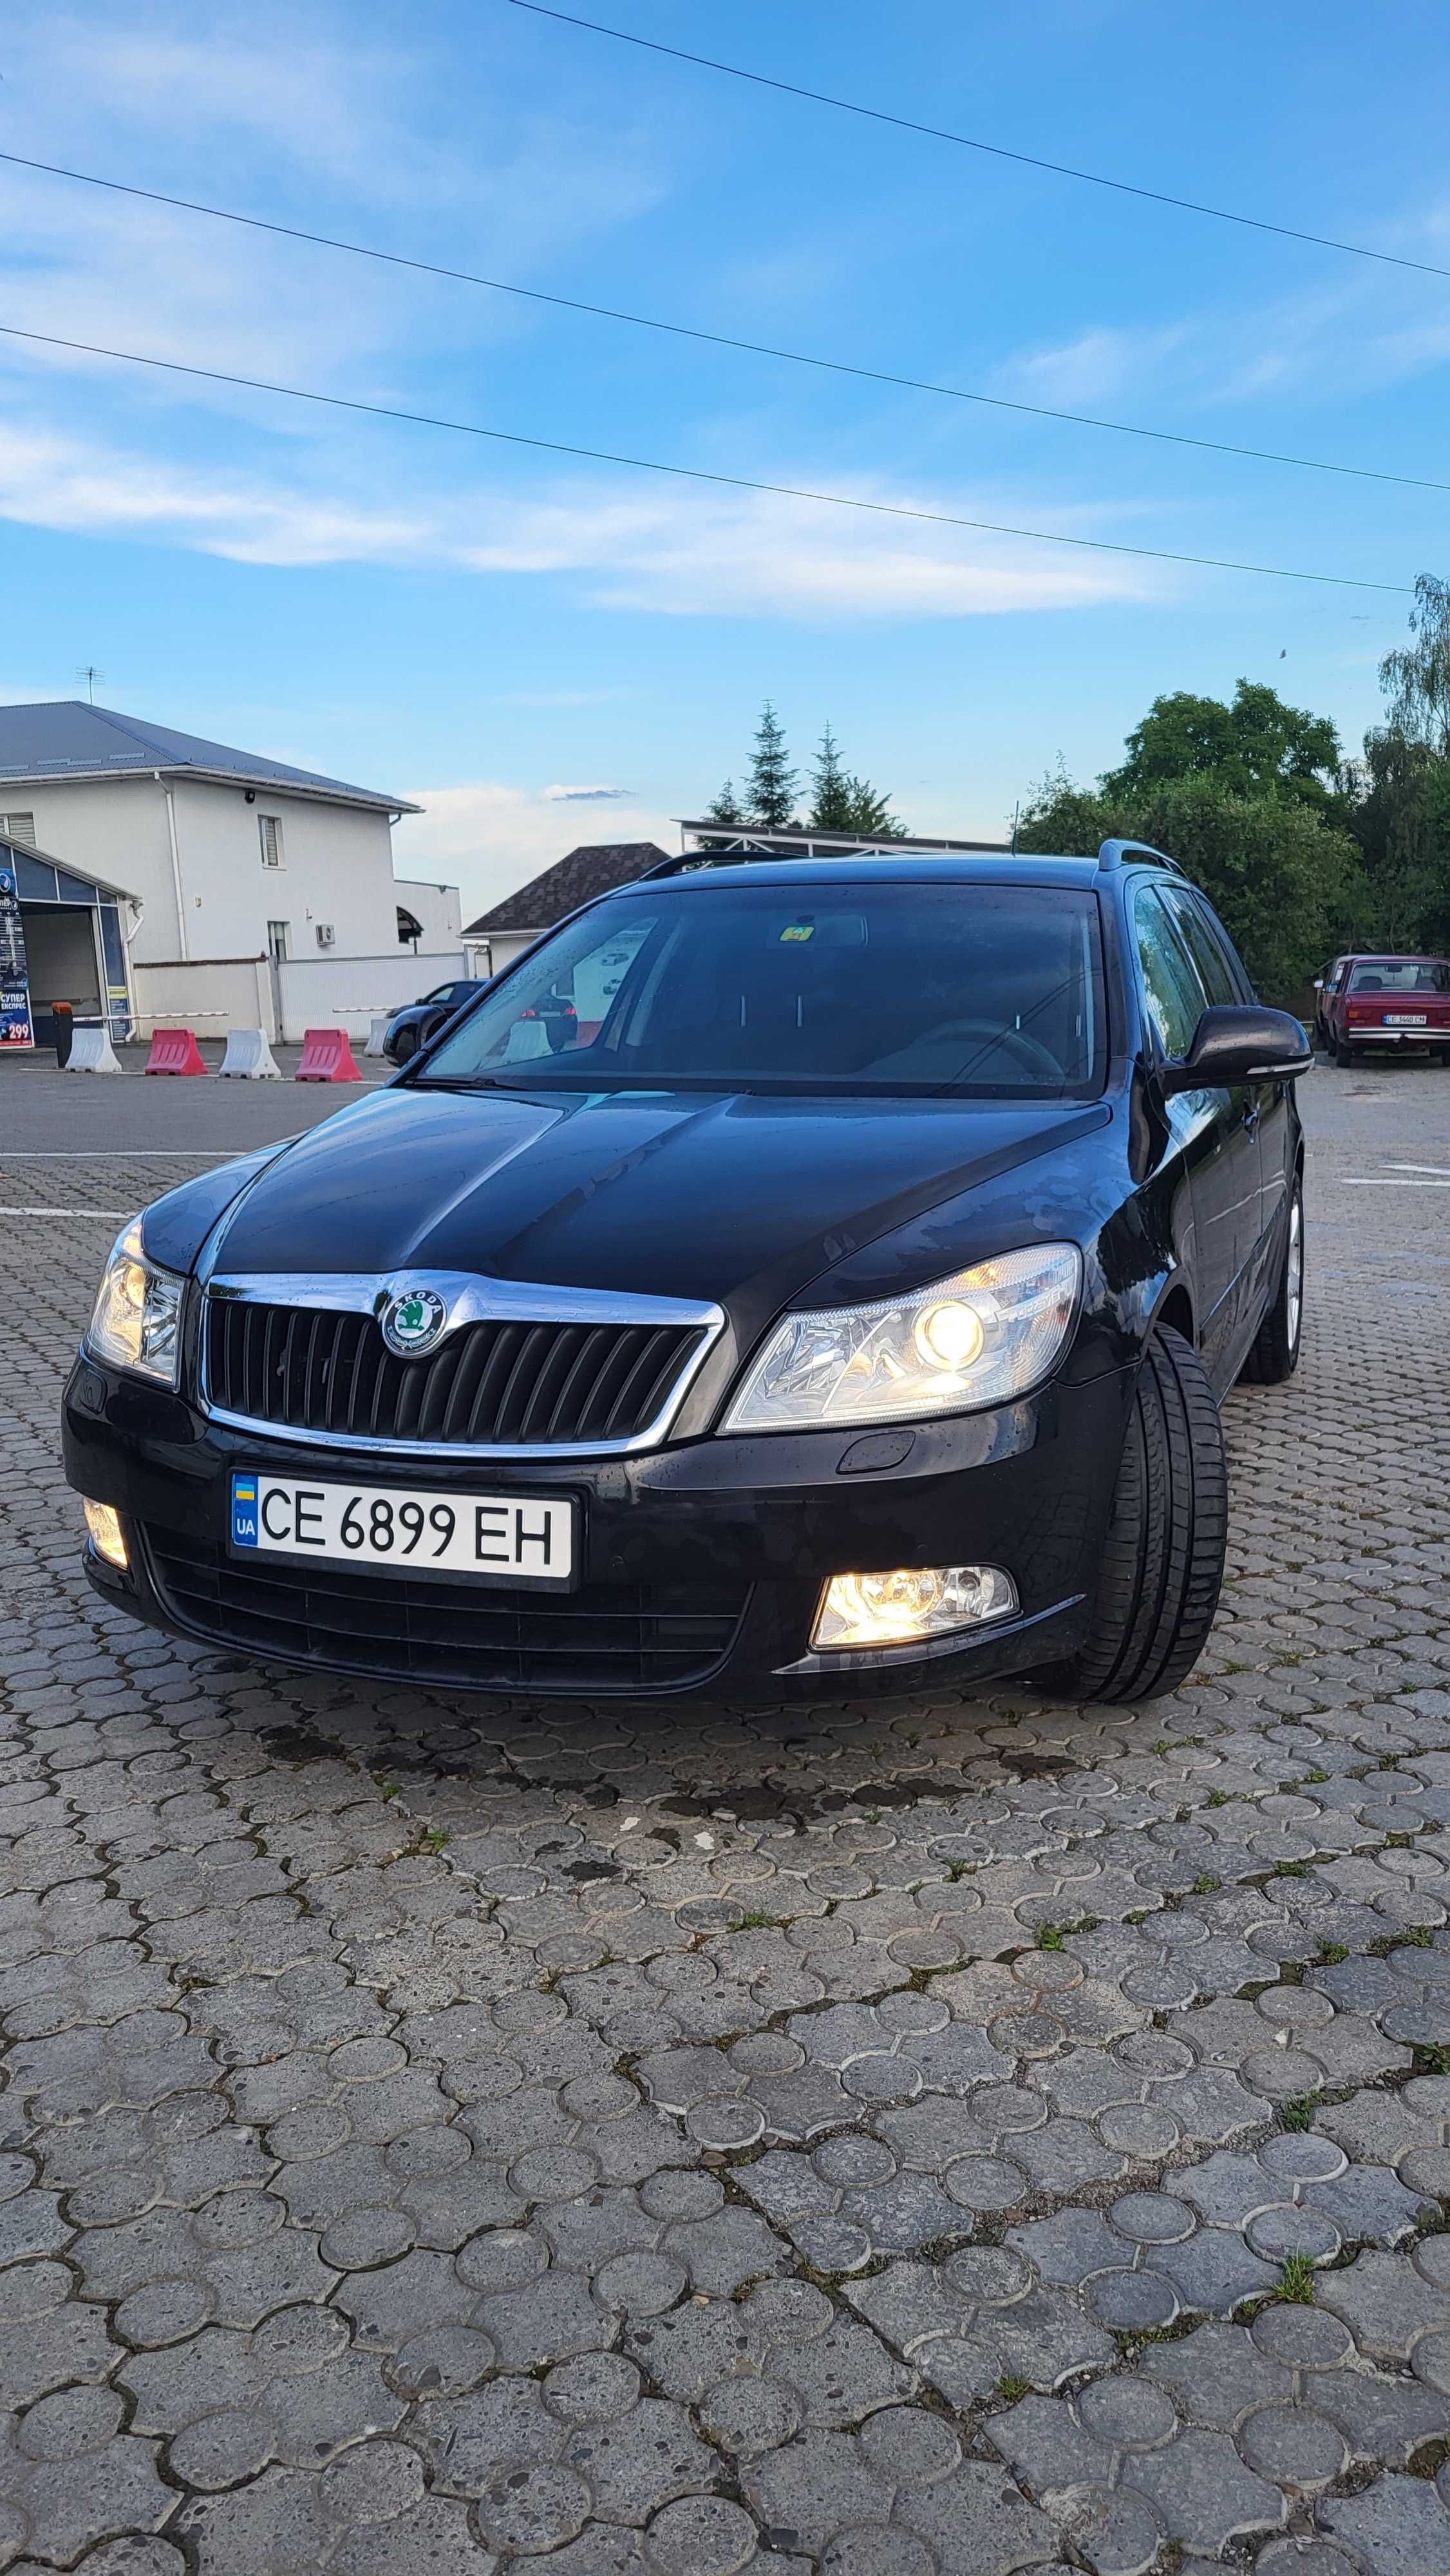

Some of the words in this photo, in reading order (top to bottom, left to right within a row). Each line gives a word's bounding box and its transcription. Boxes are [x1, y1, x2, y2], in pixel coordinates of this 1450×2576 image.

[1, 993, 25, 1003] СУПЕР
[9, 1023, 29, 1039] 299
[395, 1291, 442, 1314] SKODA
[236, 1518, 256, 1536] UA
[261, 1488, 326, 1546] CE
[340, 1497, 456, 1557] 6899
[475, 1506, 552, 1565] EH
